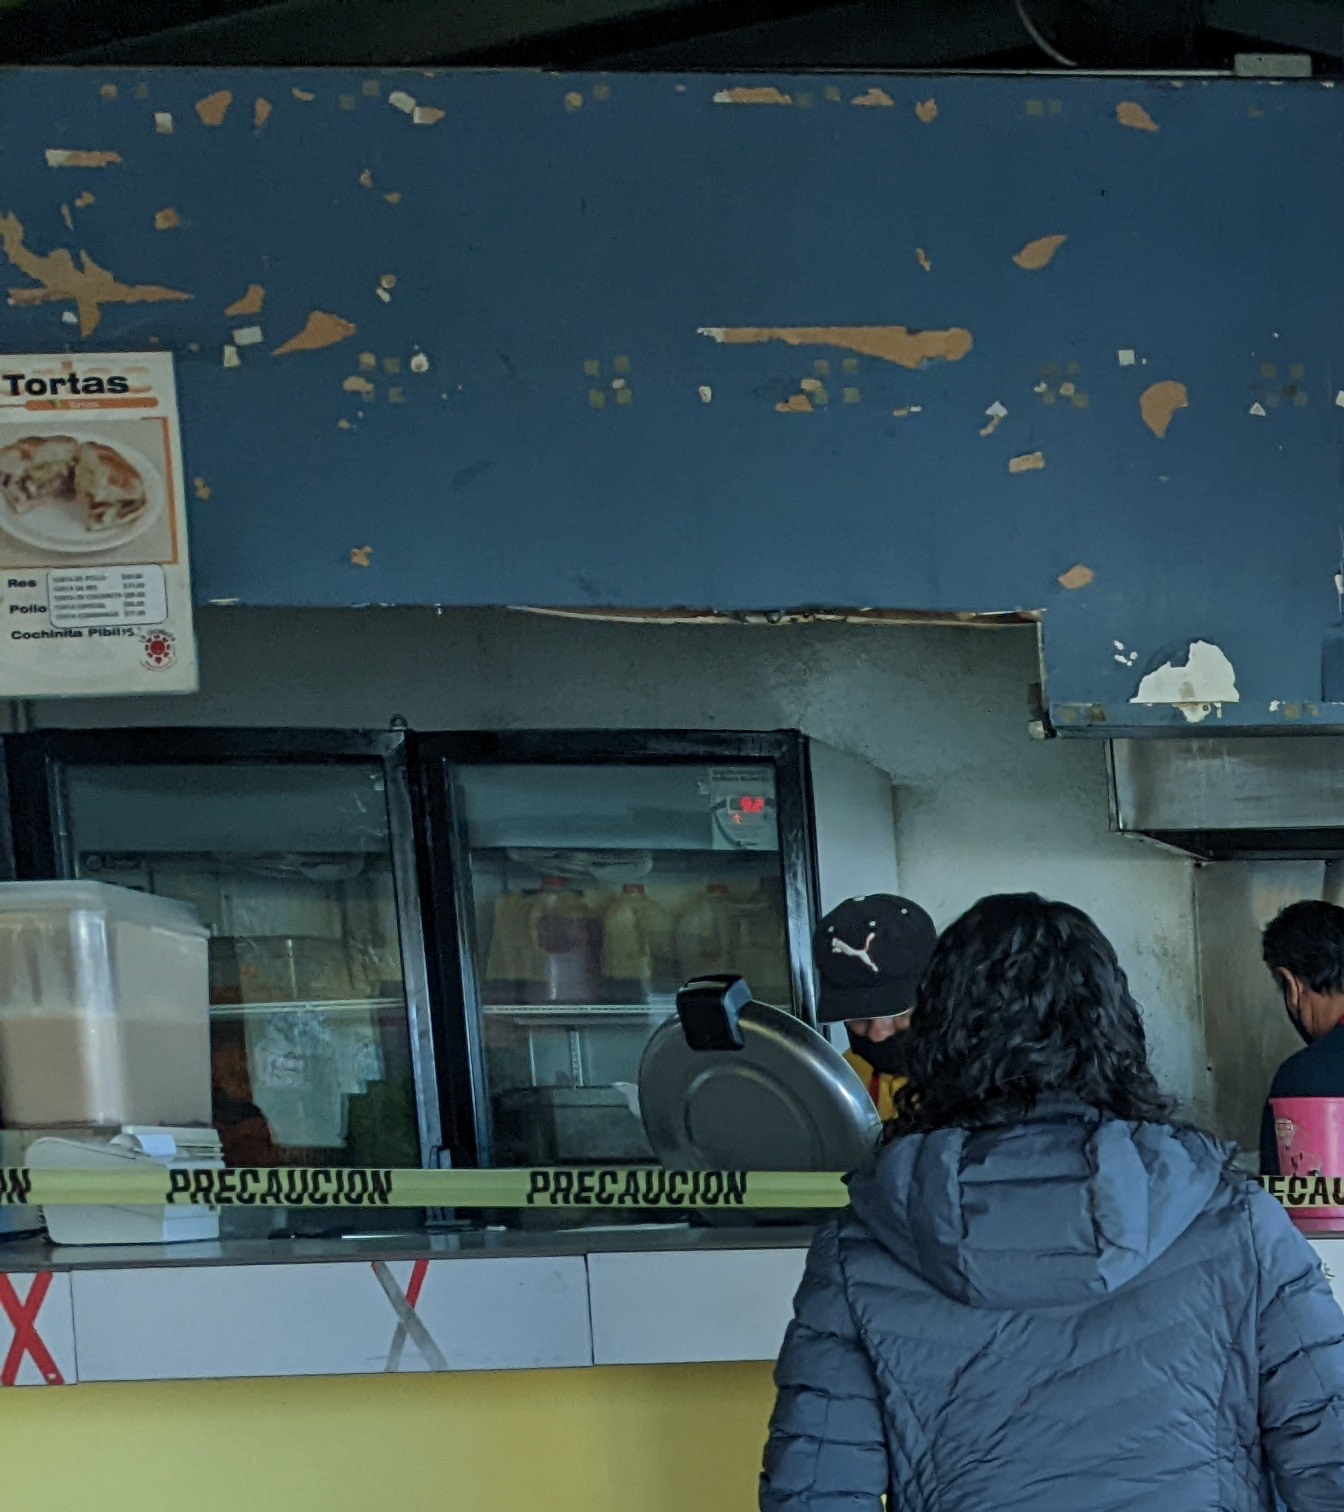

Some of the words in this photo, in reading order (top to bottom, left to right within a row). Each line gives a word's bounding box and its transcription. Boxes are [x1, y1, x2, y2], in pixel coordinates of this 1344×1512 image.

[2, 373, 129, 396] Tortas
[8, 579, 36, 587] Res
[10, 604, 46, 614] Pollo
[11, 629, 82, 639] Cochinita
[166, 1169, 392, 1205] PRECAUCION
[526, 1169, 748, 1205] PRECAUCION
